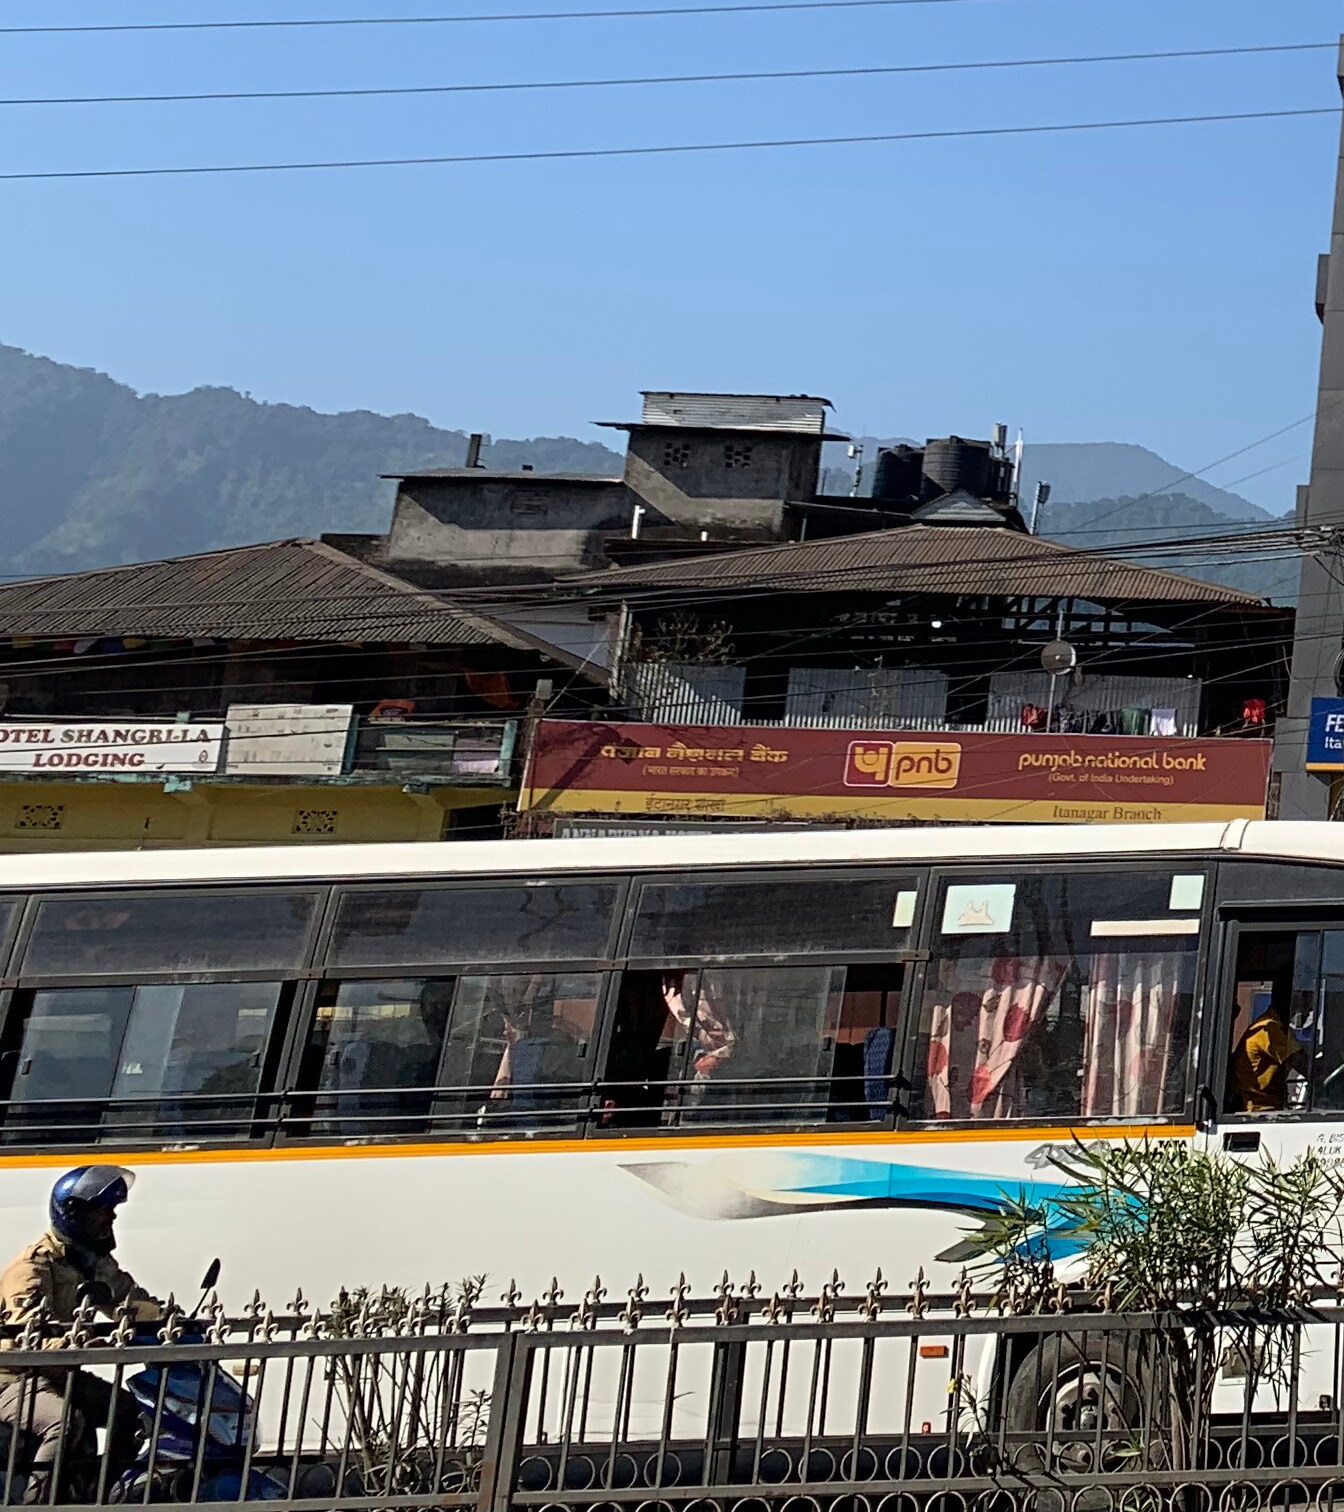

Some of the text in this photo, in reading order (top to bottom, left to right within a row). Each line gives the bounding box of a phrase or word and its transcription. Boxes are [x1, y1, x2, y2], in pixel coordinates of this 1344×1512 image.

[60, 728, 212, 744] SHANGRI-LA
[32, 753, 145, 768] LODGING
[750, 743, 789, 763] बैंक
[1018, 750, 1207, 772] punjab national bank
[895, 749, 953, 781] pnb
[1048, 772, 1174, 786] (Govt. of India Undertaking)
[1053, 805, 1162, 822] Itanagar Branch
